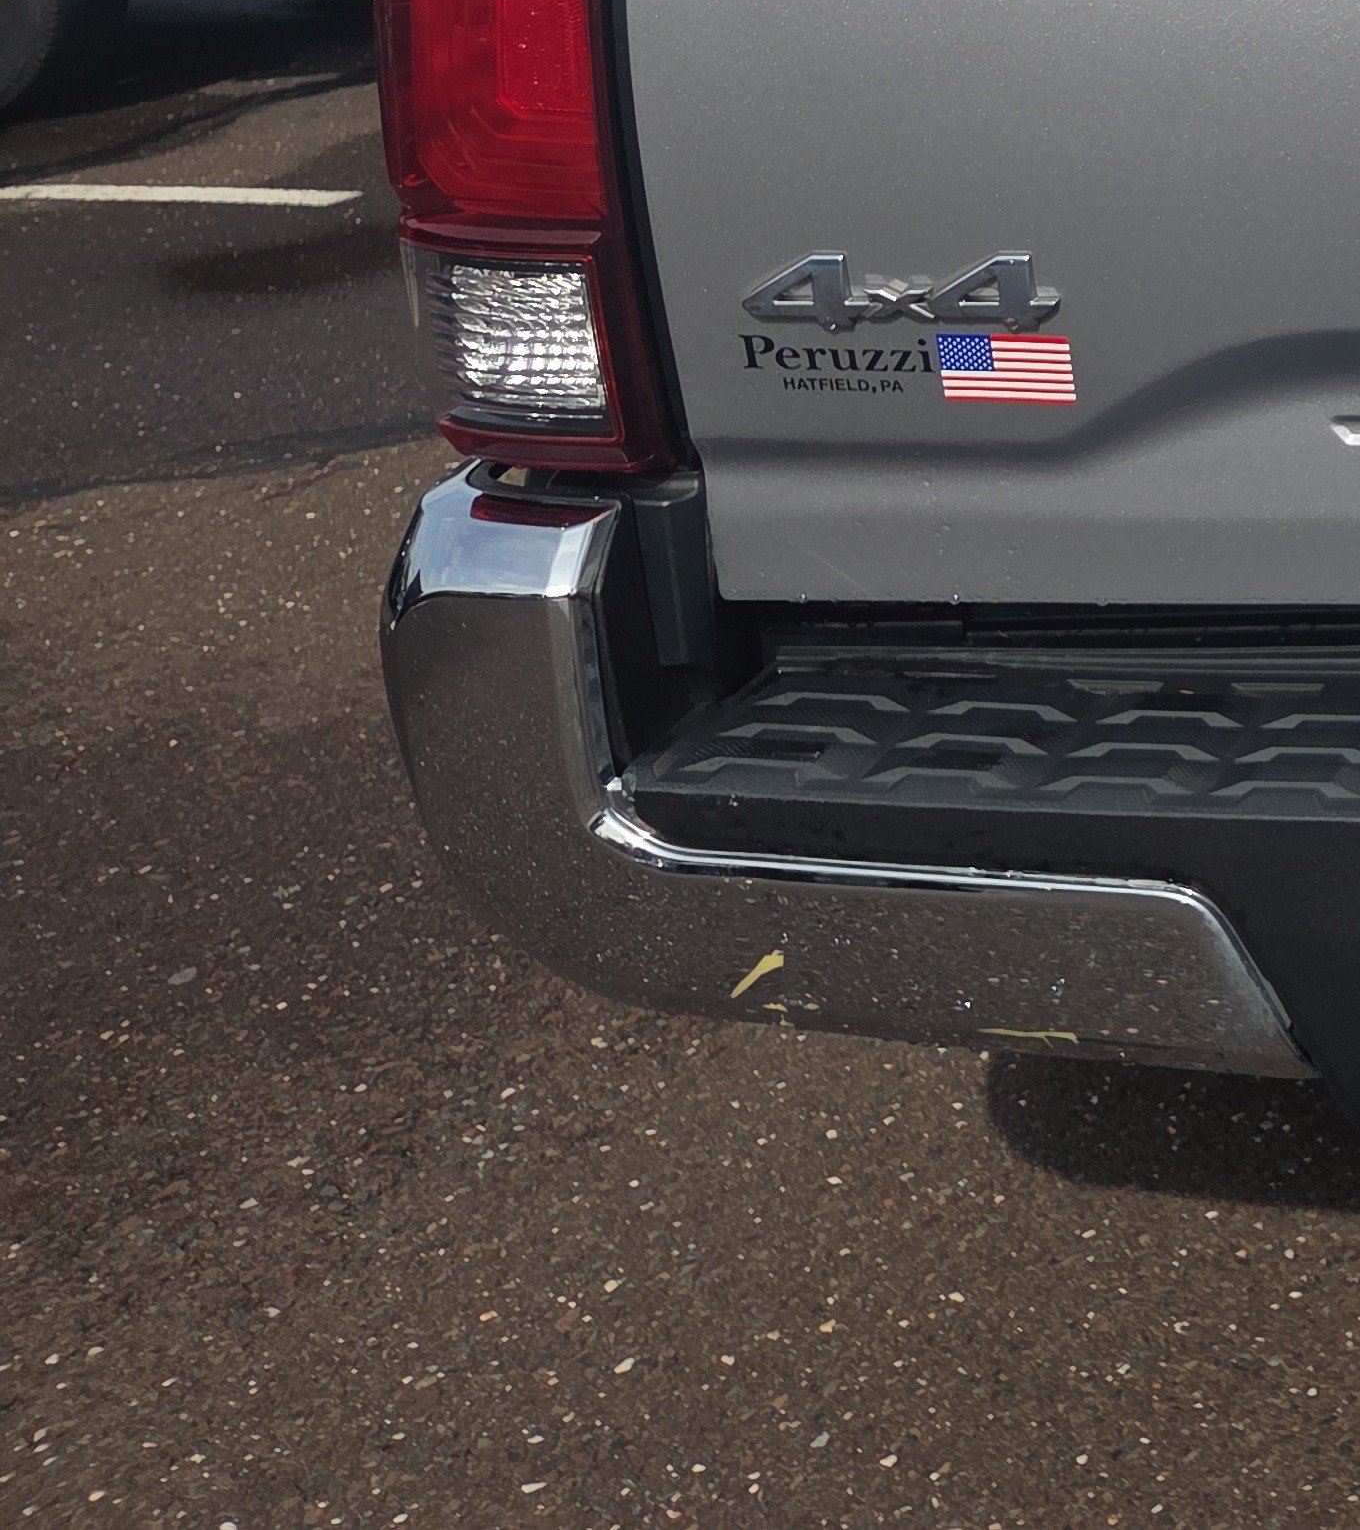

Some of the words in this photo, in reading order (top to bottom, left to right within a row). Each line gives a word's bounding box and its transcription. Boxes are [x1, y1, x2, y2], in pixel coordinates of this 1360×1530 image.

[739, 334, 936, 374] Peruzzi
[784, 376, 877, 394] HATFIELD,
[880, 380, 904, 394] PA
